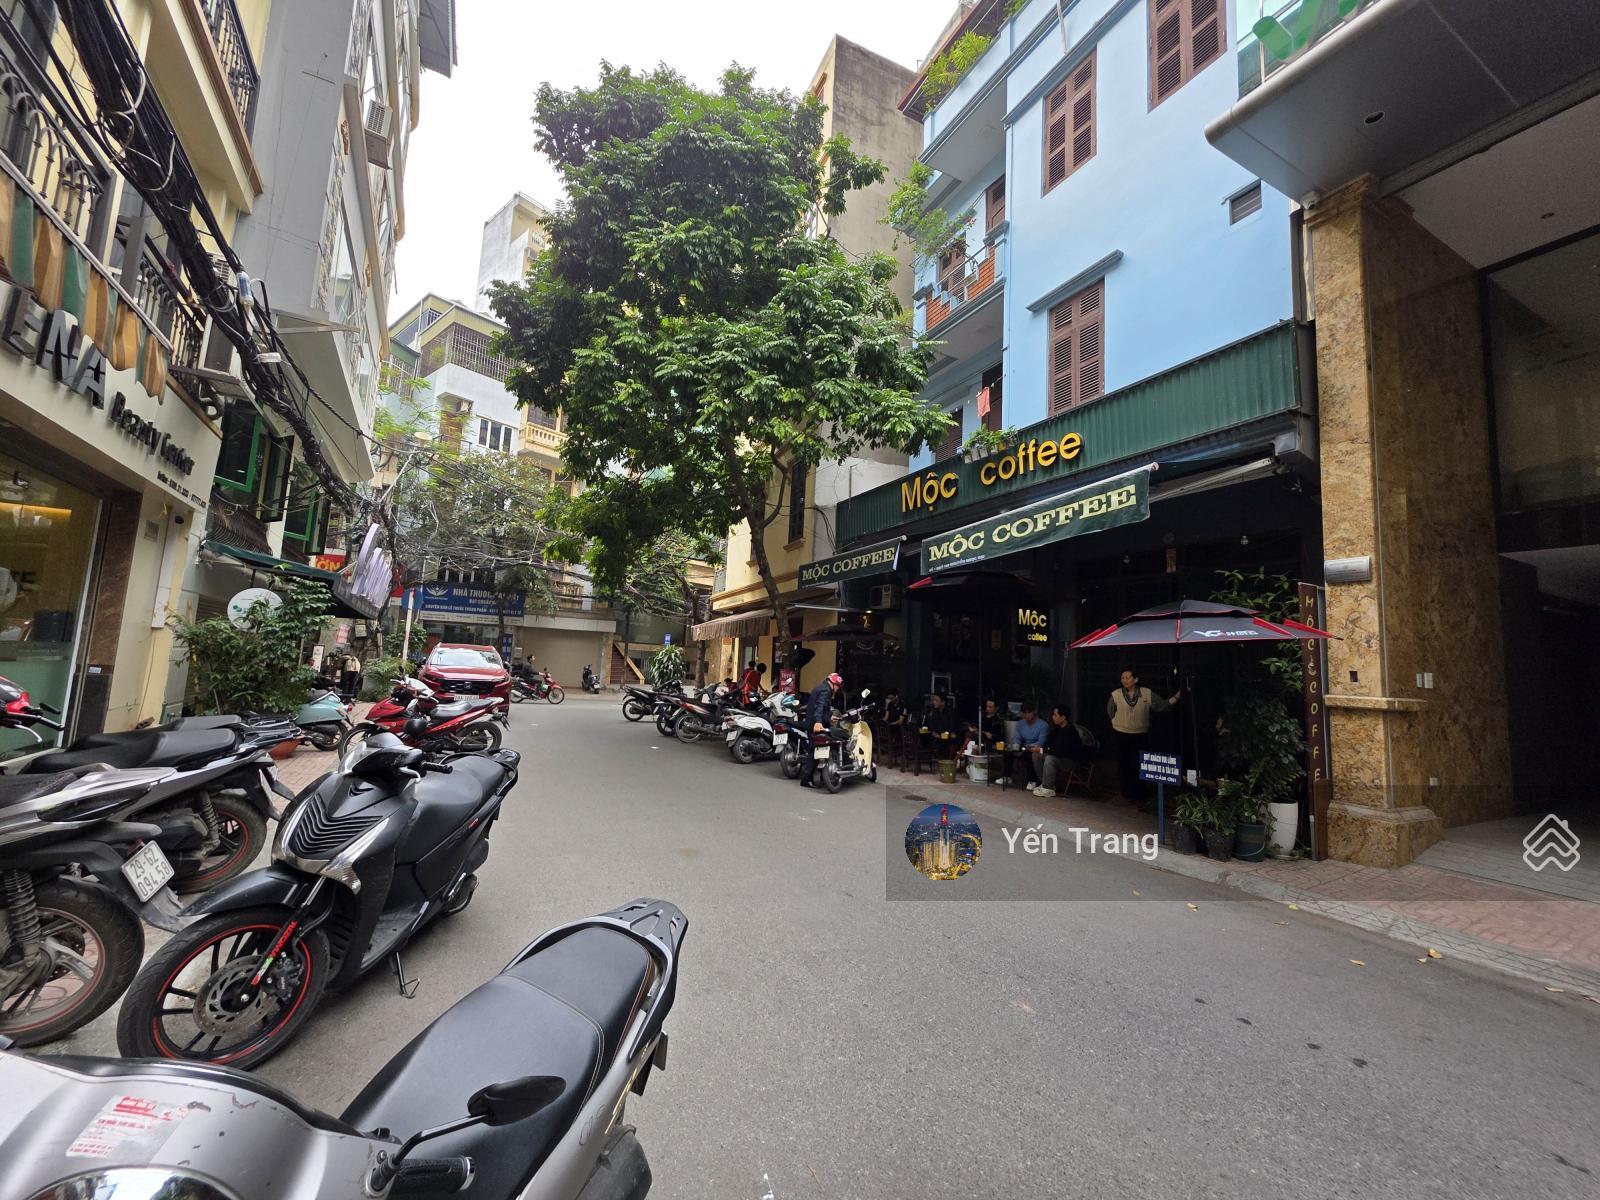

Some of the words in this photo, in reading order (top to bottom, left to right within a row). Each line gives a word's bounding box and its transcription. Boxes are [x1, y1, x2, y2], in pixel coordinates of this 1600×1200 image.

[901, 471, 957, 513] Mộc
[980, 432, 1083, 486] coffee
[928, 531, 985, 562] MỘC
[991, 484, 1138, 542] COFFEE
[802, 564, 829, 581] MỘC
[832, 547, 895, 574] COFFEE
[1018, 608, 1047, 630] Mộc
